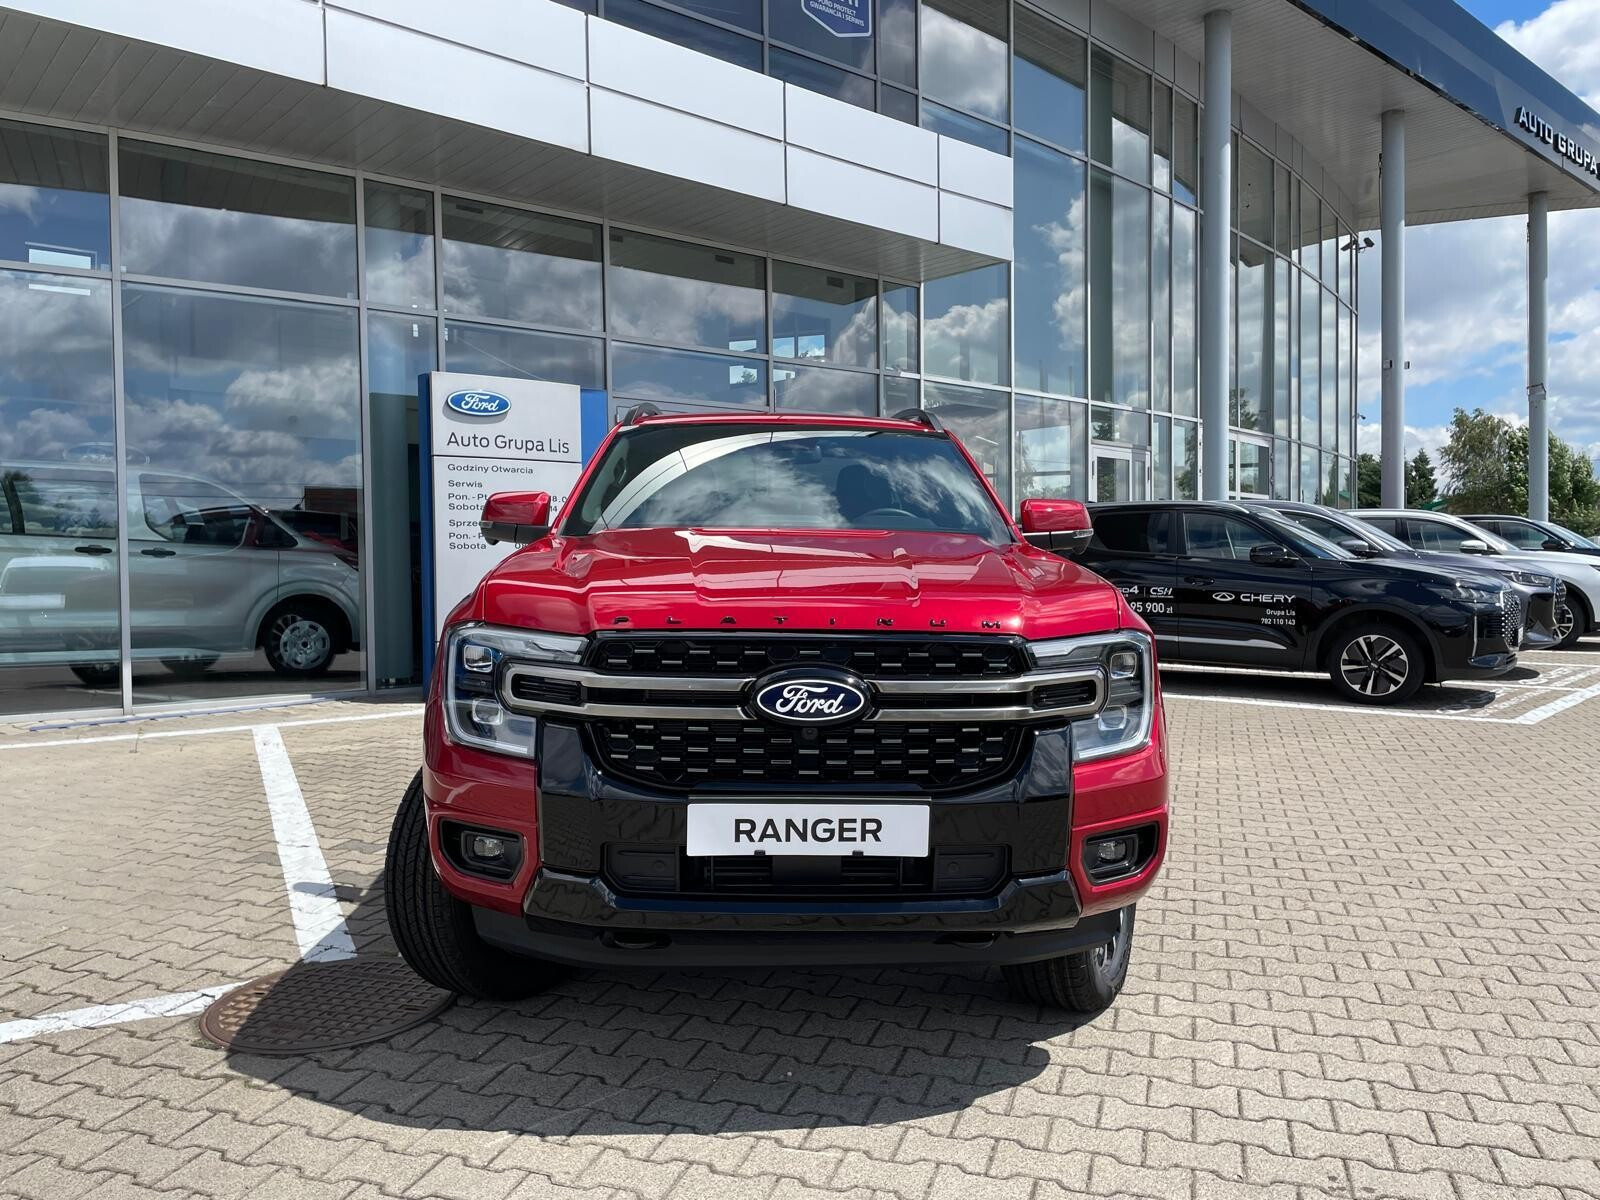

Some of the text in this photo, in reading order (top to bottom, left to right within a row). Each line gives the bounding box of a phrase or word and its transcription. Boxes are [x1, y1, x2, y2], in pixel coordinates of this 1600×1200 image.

[833, 3, 856, 17] PROTECT
[1518, 105, 1599, 175] AUTO GRUPA
[461, 393, 500, 411] Ford
[447, 431, 570, 454] Auto Grupa Lis
[447, 463, 534, 474] Godziny Otwarcia
[448, 480, 483, 488] Serwis
[449, 542, 487, 550] Sobota
[1240, 593, 1296, 603] CHERY
[1145, 601, 1165, 613] 900
[613, 615, 1002, 629] PLATINUM
[776, 685, 845, 714] Ford
[734, 818, 883, 843] RANGER
